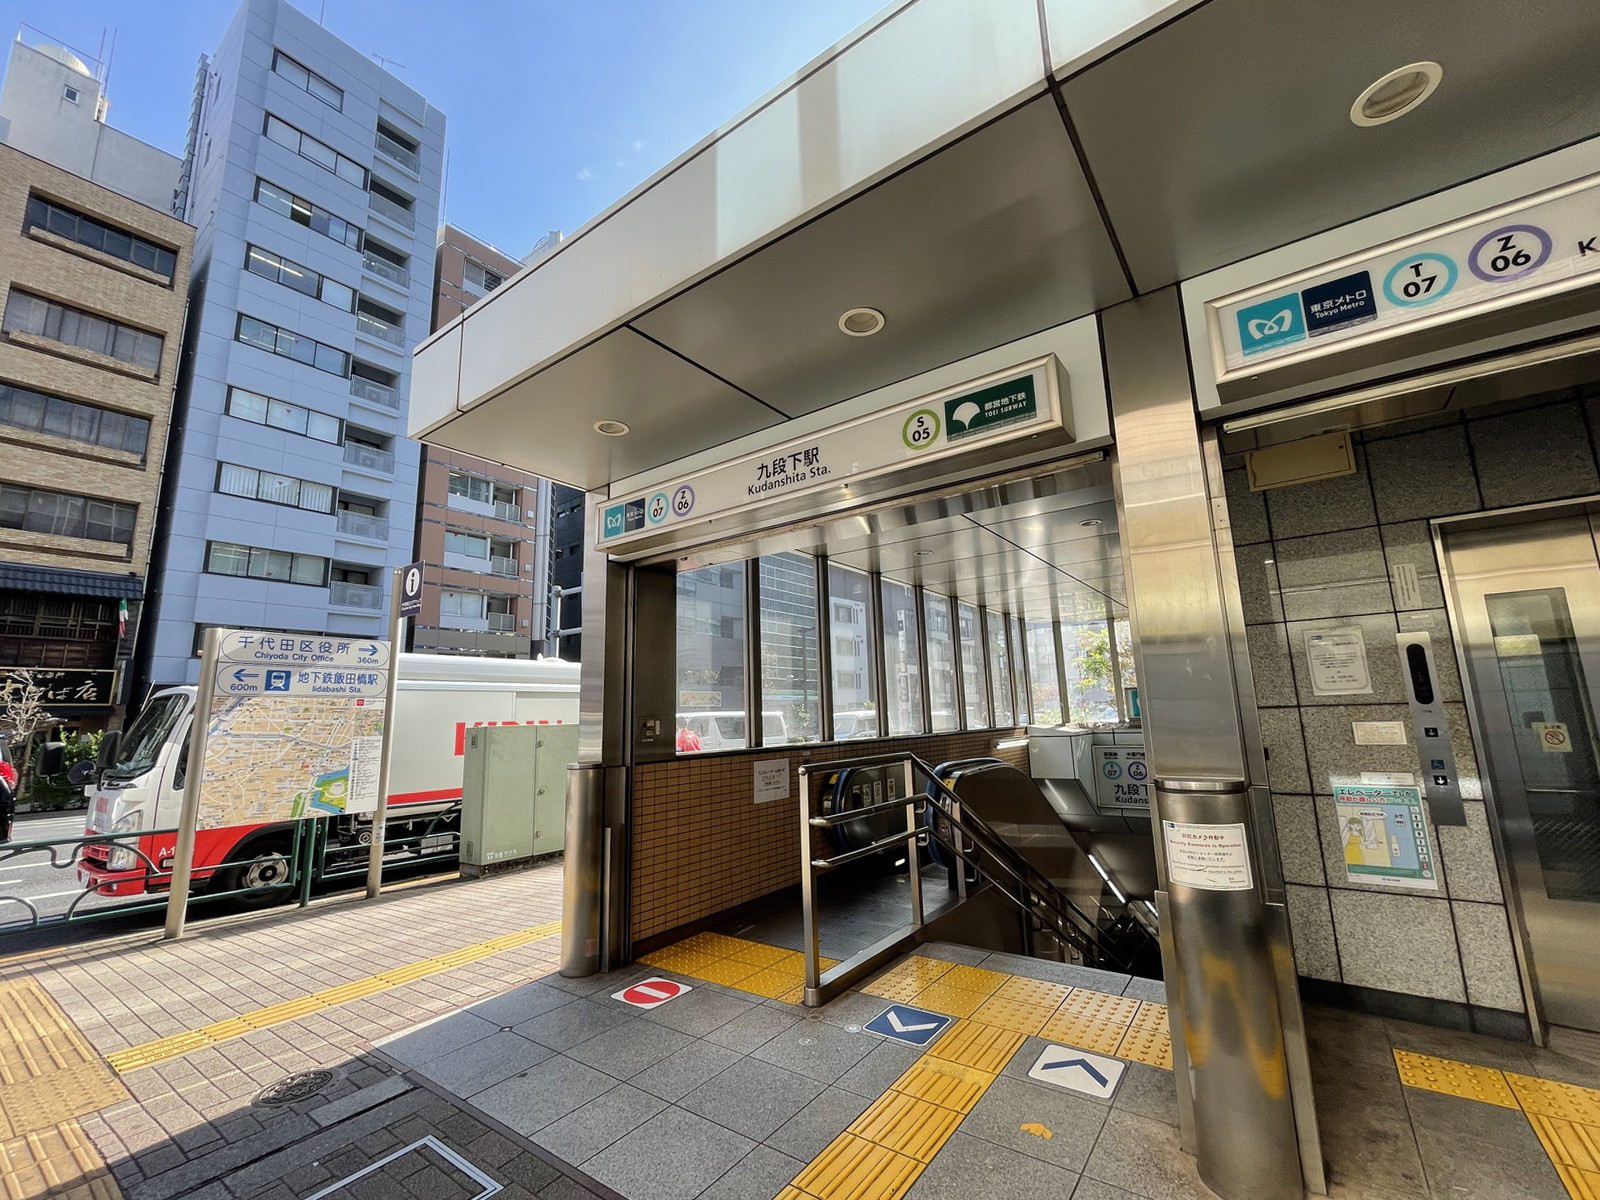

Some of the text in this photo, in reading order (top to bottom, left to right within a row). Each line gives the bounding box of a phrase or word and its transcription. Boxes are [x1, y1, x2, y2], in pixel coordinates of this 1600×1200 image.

[1497, 234, 1516, 252] Z
[1491, 249, 1531, 272] 06
[1409, 262, 1423, 277] T
[1403, 275, 1437, 298] 07
[1310, 290, 1366, 313] 東京メトロ
[1315, 300, 1365, 318] Tokyo Metro
[1000, 401, 1027, 413] SUBWAY
[917, 416, 925, 428] S
[912, 427, 930, 442] 05
[757, 447, 819, 481] 九段下駅
[748, 466, 831, 495] Kudanshita Sta.
[656, 498, 661, 506] T
[681, 490, 686, 500] Z
[653, 507, 663, 517] 07
[677, 500, 689, 510] 06
[238, 636, 350, 655] 千代田区役所
[254, 651, 334, 662] Chiyoda City Office
[357, 657, 379, 665] 360m
[297, 671, 378, 685] 地下鉄飯田橋駅
[230, 683, 257, 692] 600m
[312, 685, 362, 694] Iidabashi Sta.
